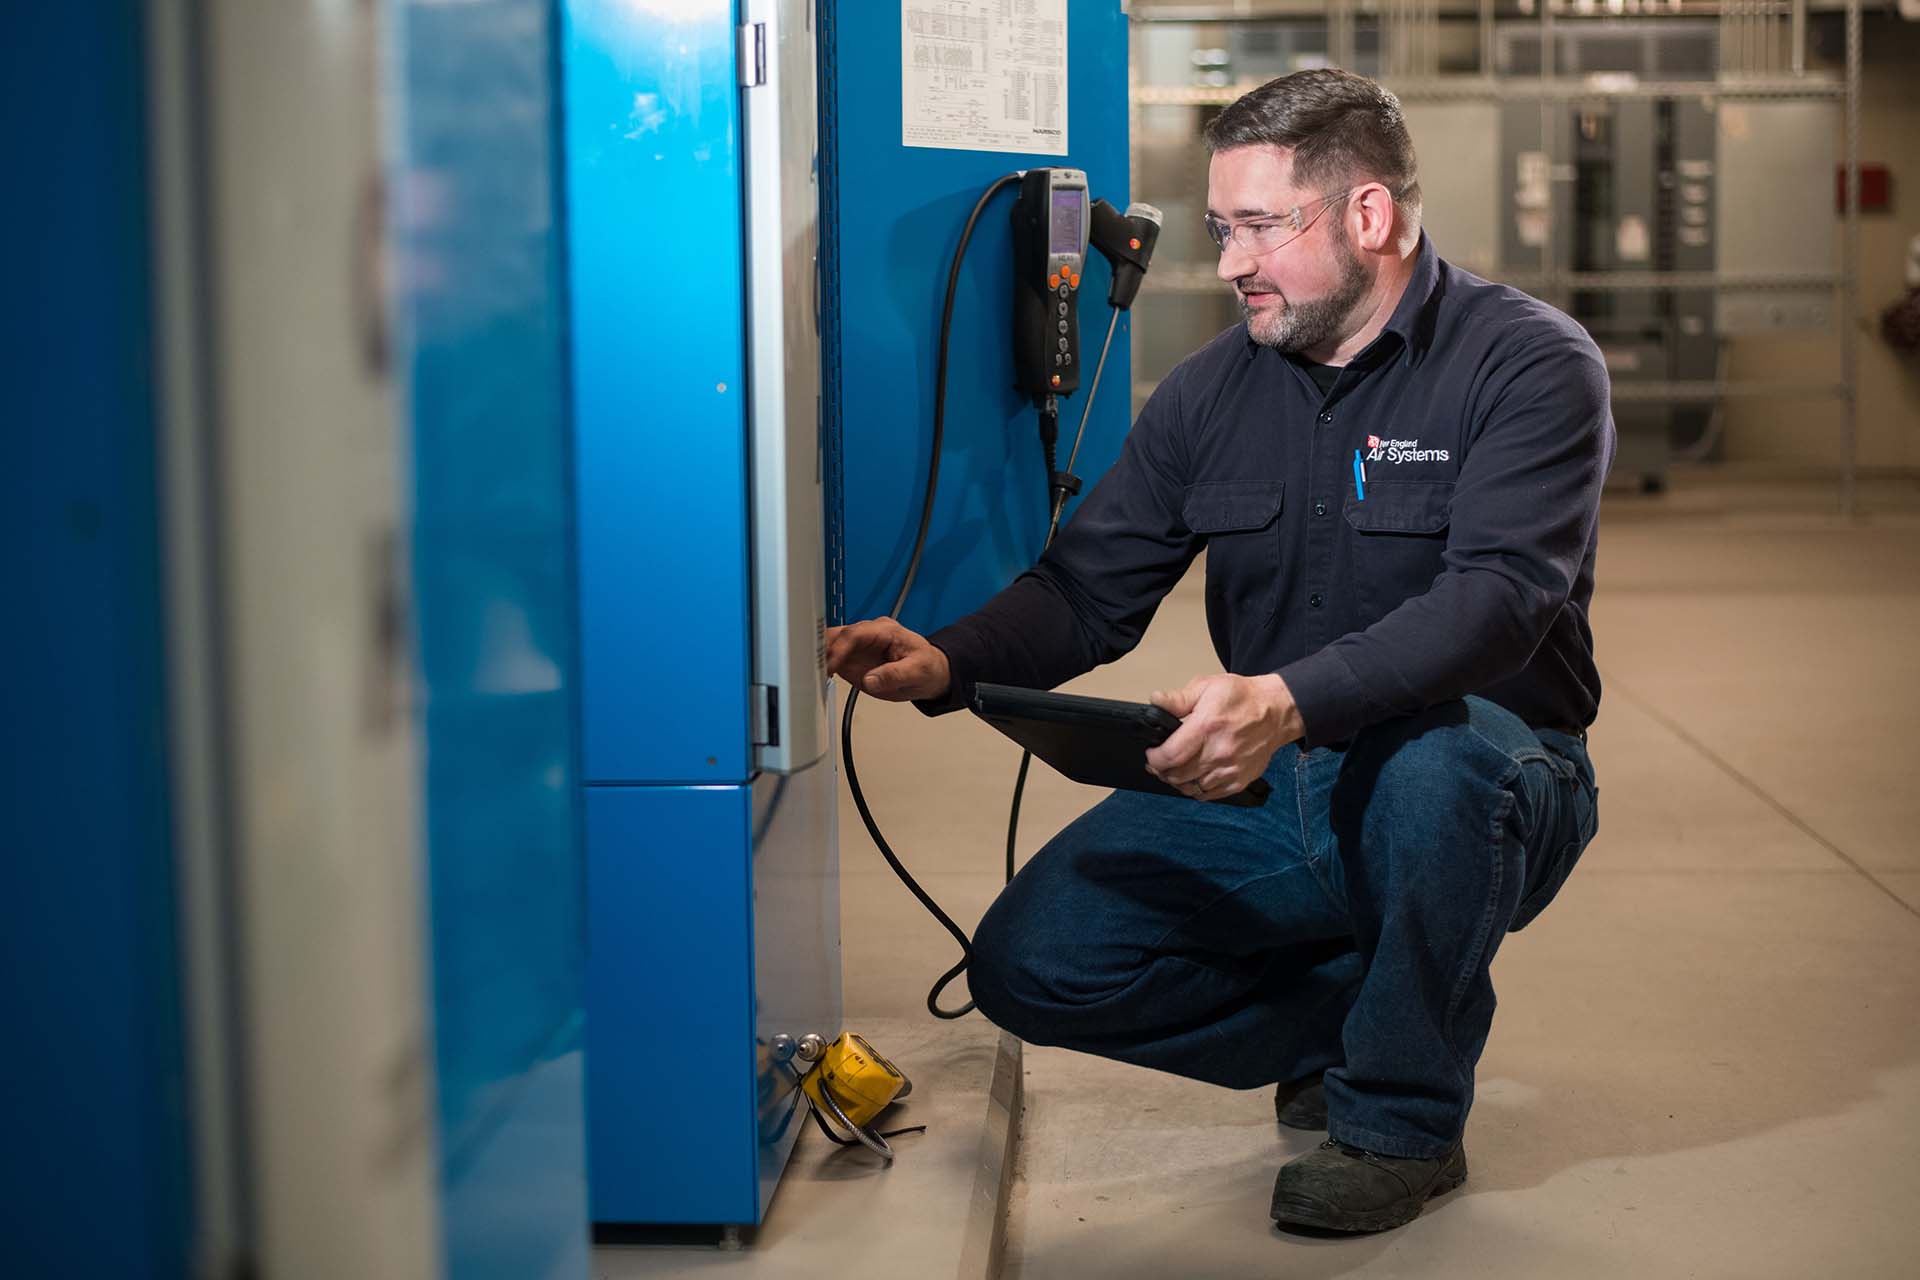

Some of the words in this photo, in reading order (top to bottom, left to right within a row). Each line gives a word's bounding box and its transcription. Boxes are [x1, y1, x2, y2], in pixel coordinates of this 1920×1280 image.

[1390, 439, 1418, 449] England
[1366, 447, 1385, 461] Air
[1387, 447, 1449, 464] Systems
